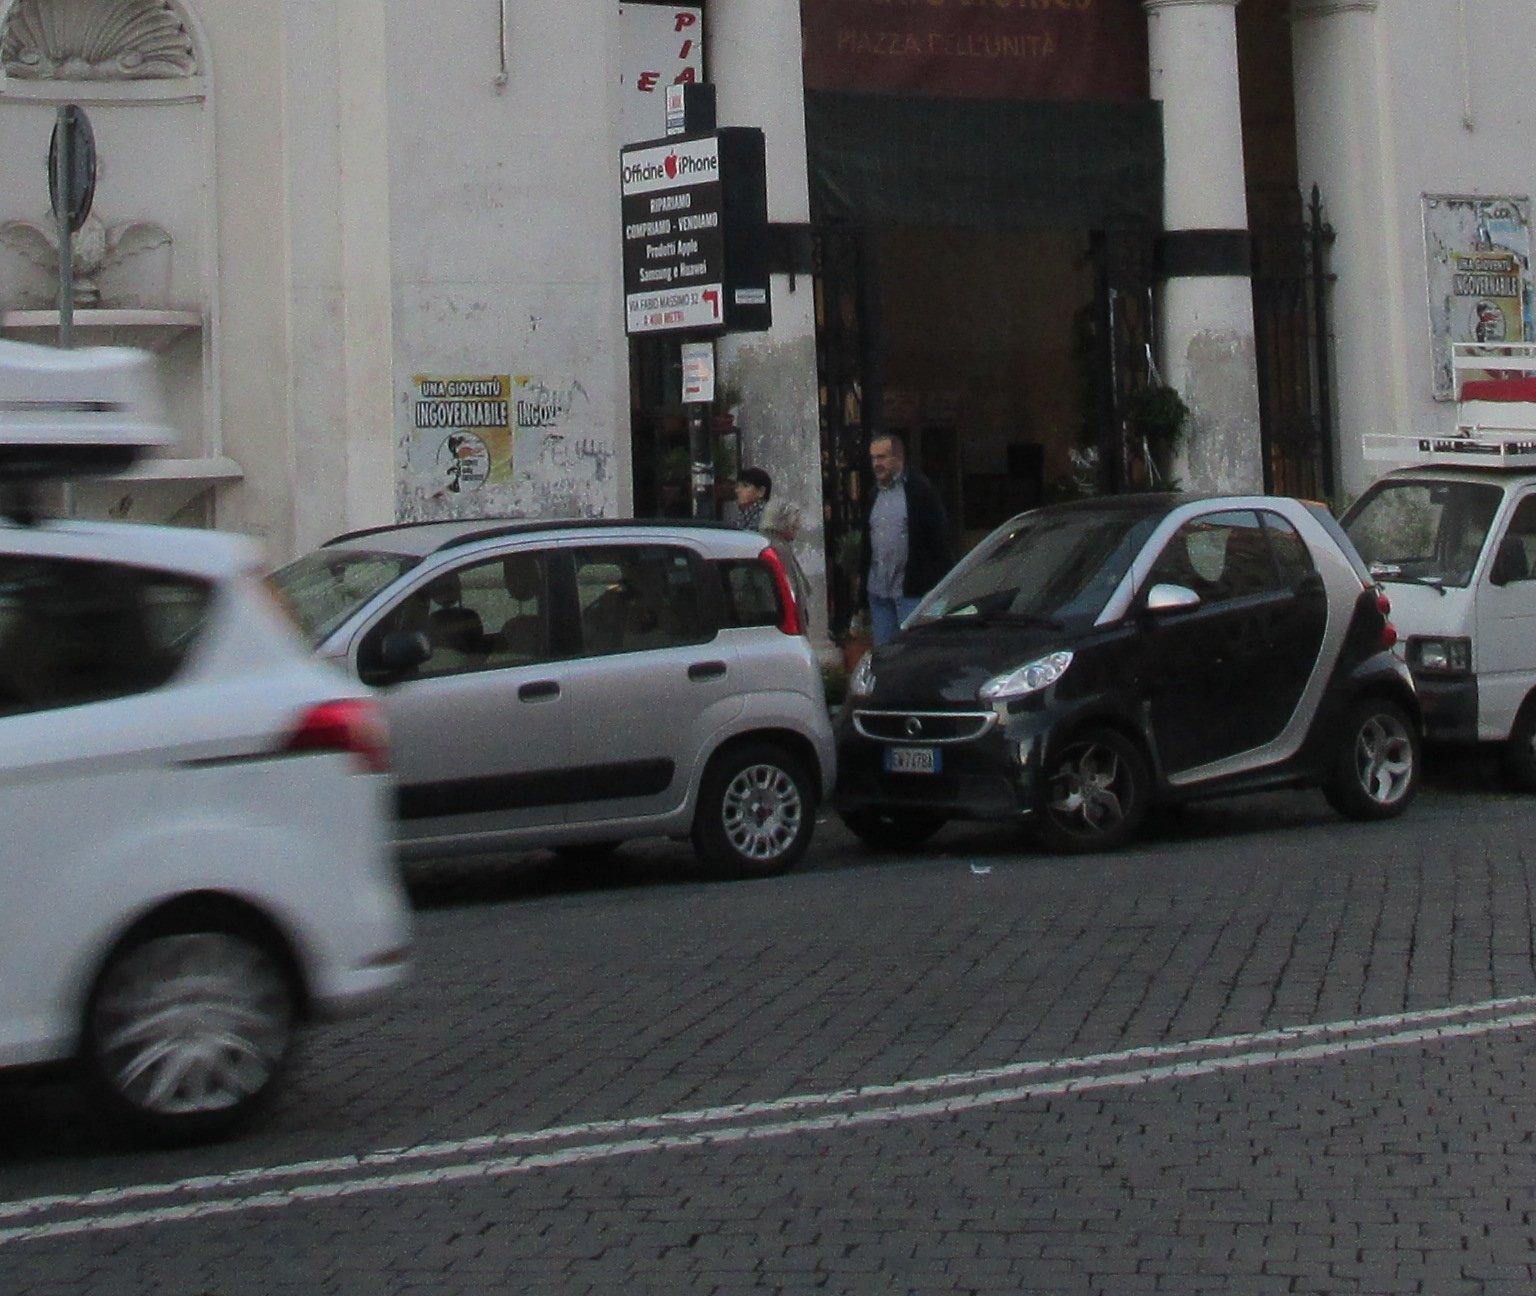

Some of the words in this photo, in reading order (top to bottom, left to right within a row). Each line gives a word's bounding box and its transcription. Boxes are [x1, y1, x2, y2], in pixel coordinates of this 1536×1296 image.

[623, 163, 664, 184] Officine
[678, 154, 717, 175] iPhone
[421, 381, 446, 397] UNA
[447, 376, 502, 396] GIOVENTÙ
[415, 400, 508, 427] INGOVERNABILE
